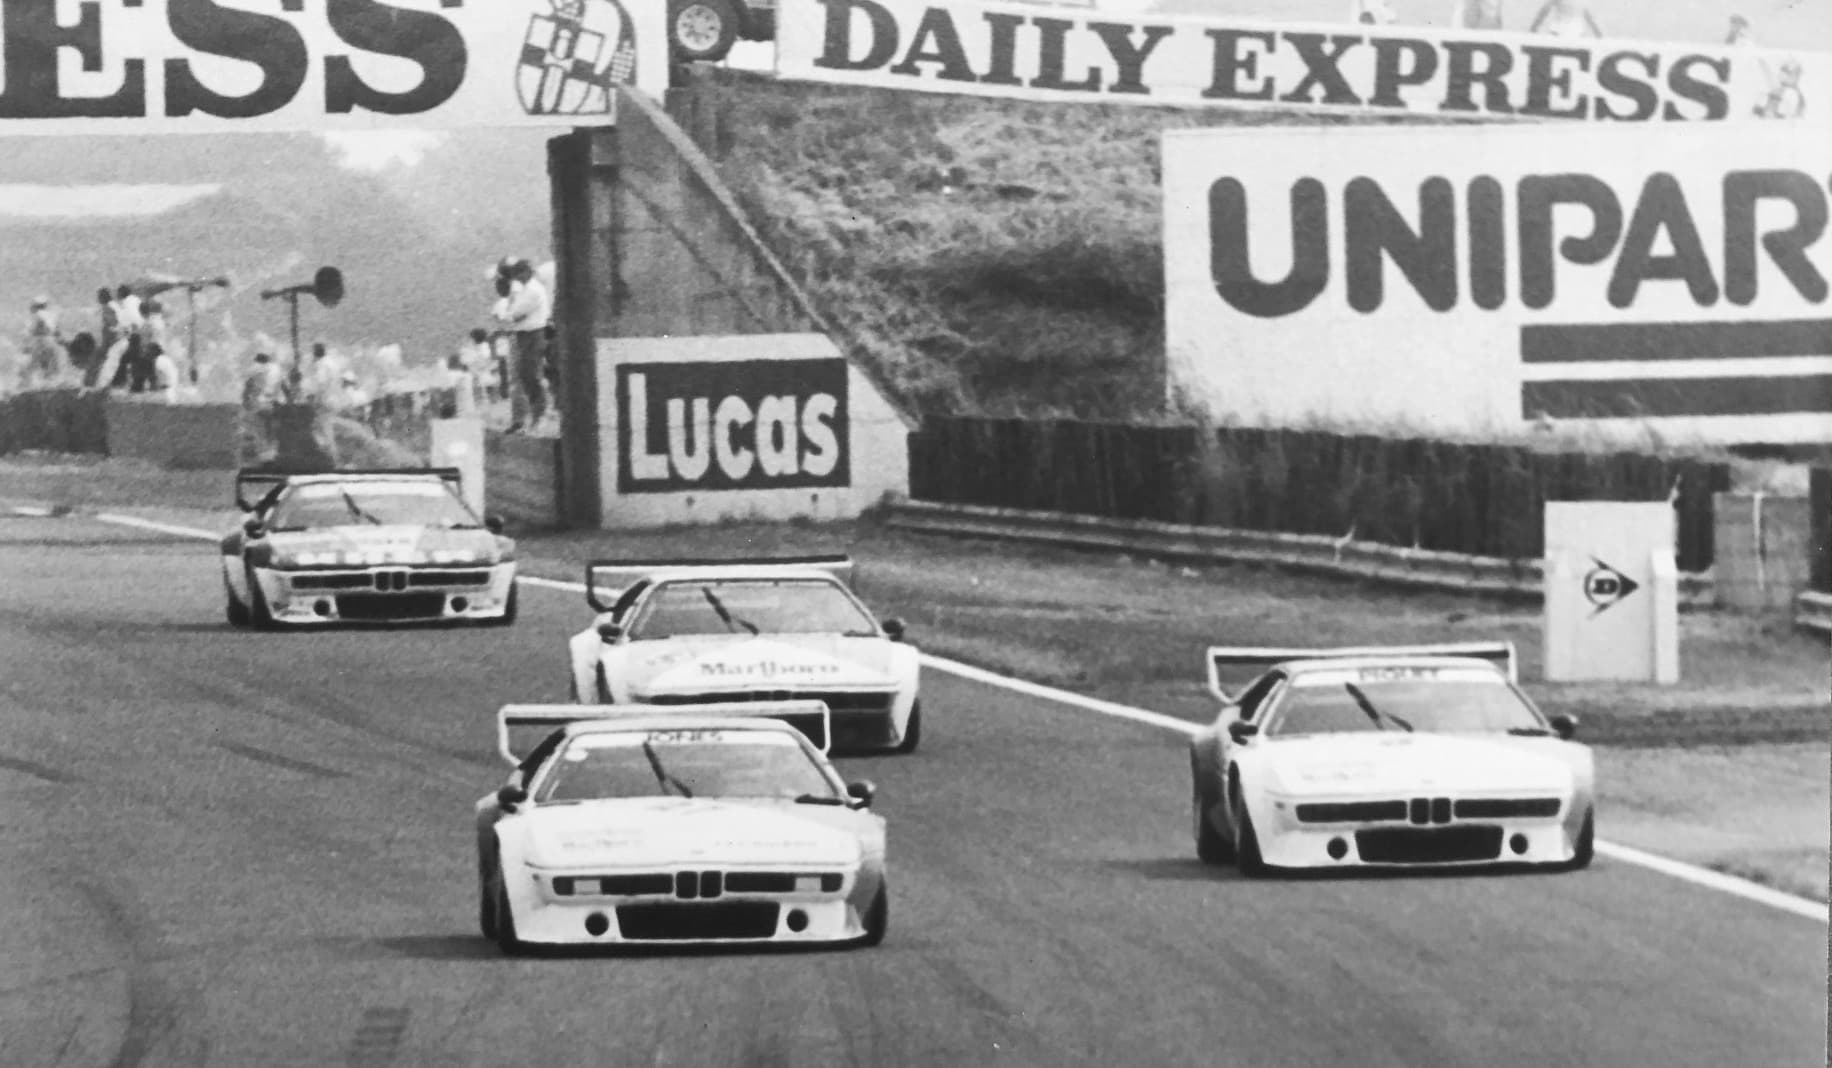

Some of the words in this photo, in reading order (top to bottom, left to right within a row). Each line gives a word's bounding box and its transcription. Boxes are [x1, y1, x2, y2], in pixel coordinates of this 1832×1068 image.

[813, 0, 1174, 95] DAILY
[1201, 28, 1731, 122] EXPRESS
[1208, 169, 1832, 318] UNIPAR
